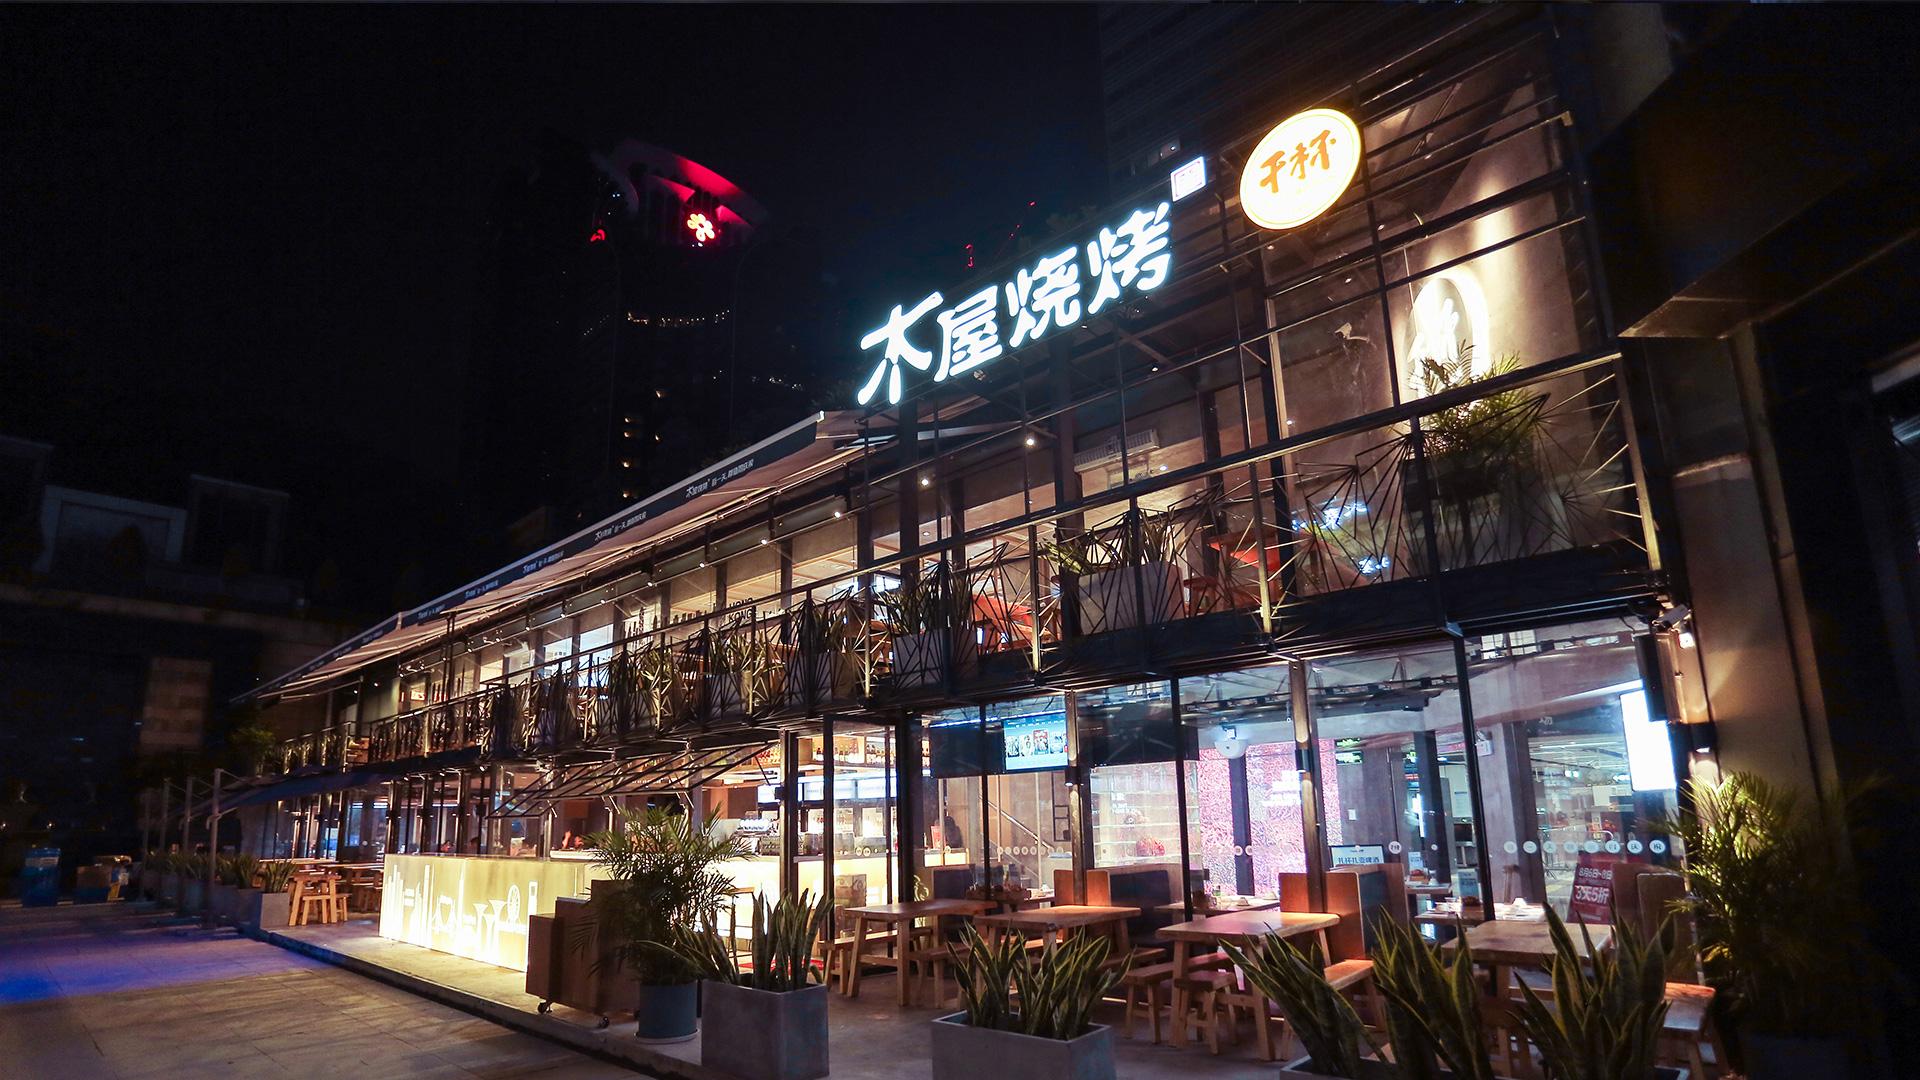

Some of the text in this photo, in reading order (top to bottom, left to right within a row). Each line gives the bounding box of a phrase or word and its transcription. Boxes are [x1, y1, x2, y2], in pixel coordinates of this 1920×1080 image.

[858, 201, 1172, 405] 木屋烧烤
[1574, 885, 1610, 904] 3天5折
